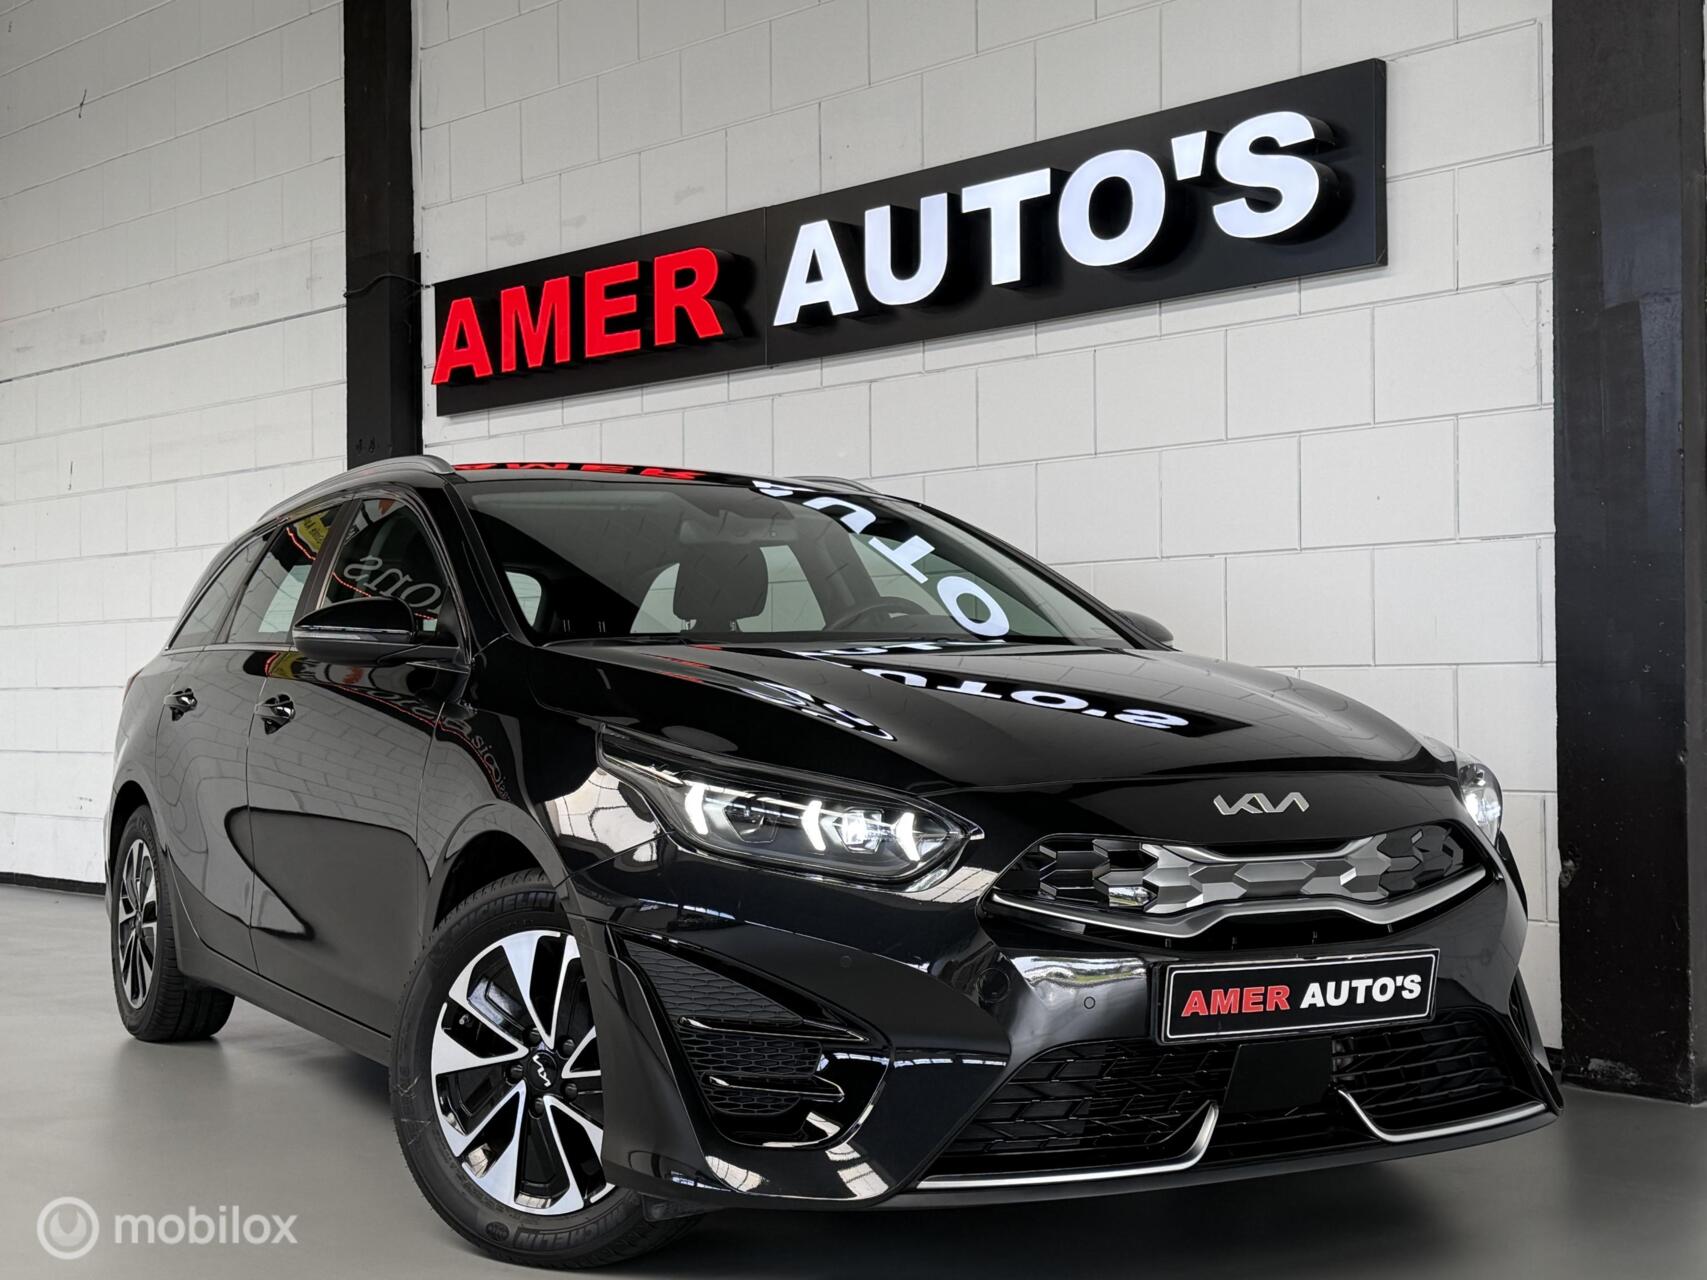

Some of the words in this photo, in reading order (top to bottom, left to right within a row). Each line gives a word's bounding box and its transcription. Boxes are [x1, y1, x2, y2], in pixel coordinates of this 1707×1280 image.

[430, 246, 725, 385] AMER
[772, 109, 1320, 327] AUTO'S
[1213, 791, 1310, 815] KIA
[1181, 984, 1291, 1017] AMER
[1299, 974, 1422, 1009] AUTO'S
